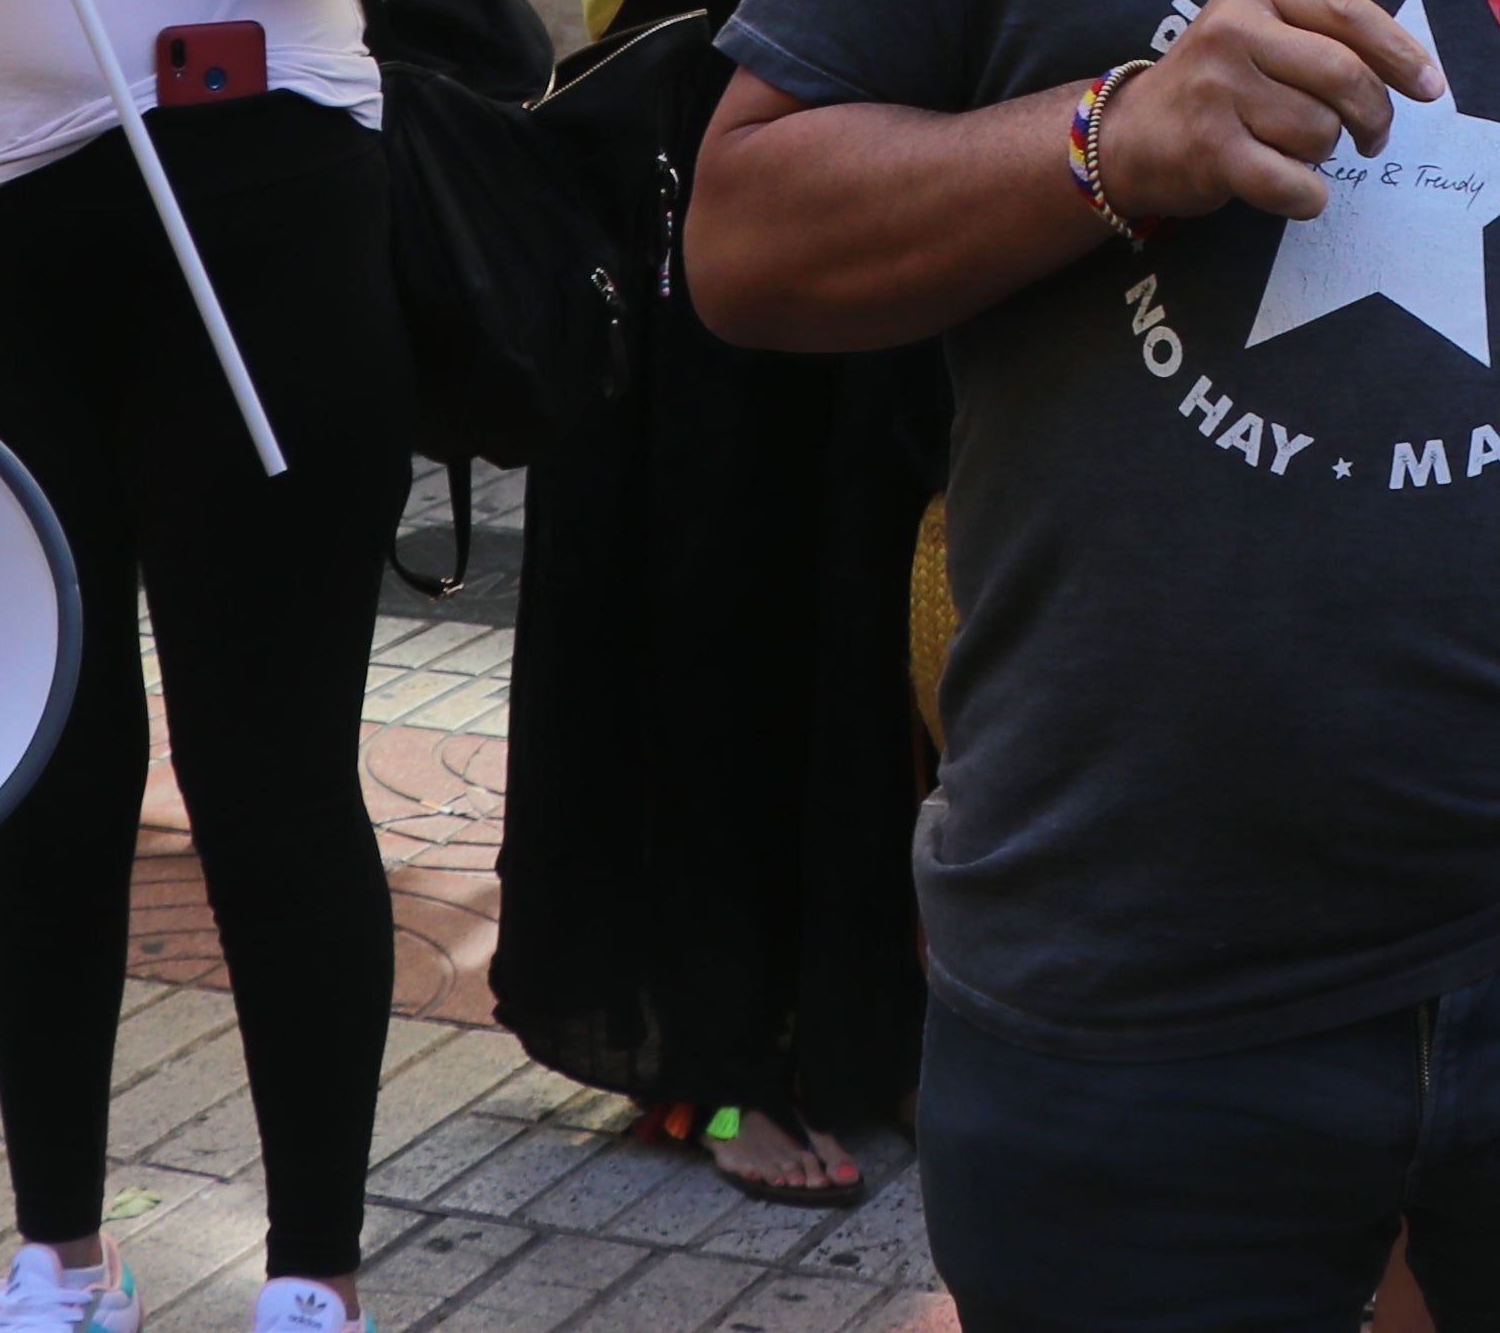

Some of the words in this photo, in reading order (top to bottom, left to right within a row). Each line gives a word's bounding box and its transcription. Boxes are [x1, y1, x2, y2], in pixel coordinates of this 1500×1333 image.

[1381, 162, 1402, 187] &
[1125, 273, 1184, 378] NO
[1178, 374, 1315, 476] HAY
